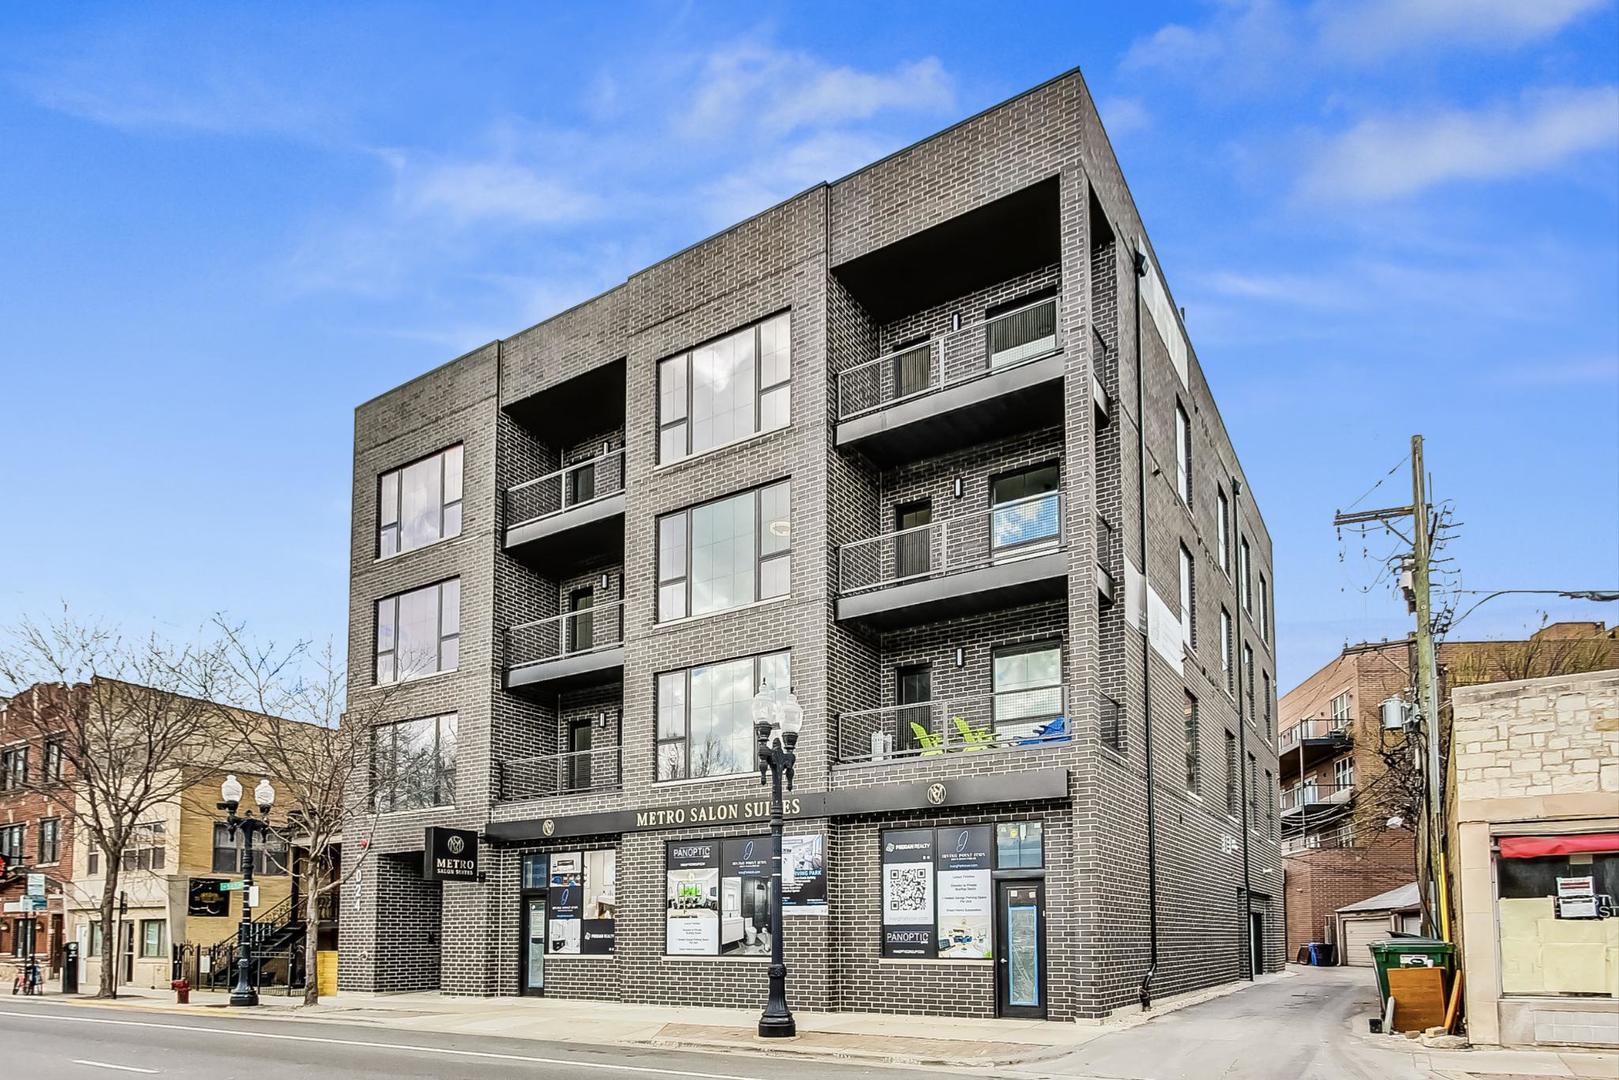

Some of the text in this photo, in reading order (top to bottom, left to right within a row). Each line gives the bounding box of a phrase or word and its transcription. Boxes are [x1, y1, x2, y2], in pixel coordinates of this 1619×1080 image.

[636, 799, 800, 827] METRO SALON SUIES
[673, 847, 711, 857] PANOPTIC
[436, 858, 475, 870] METRO
[886, 932, 929, 941] PANOPTIC
